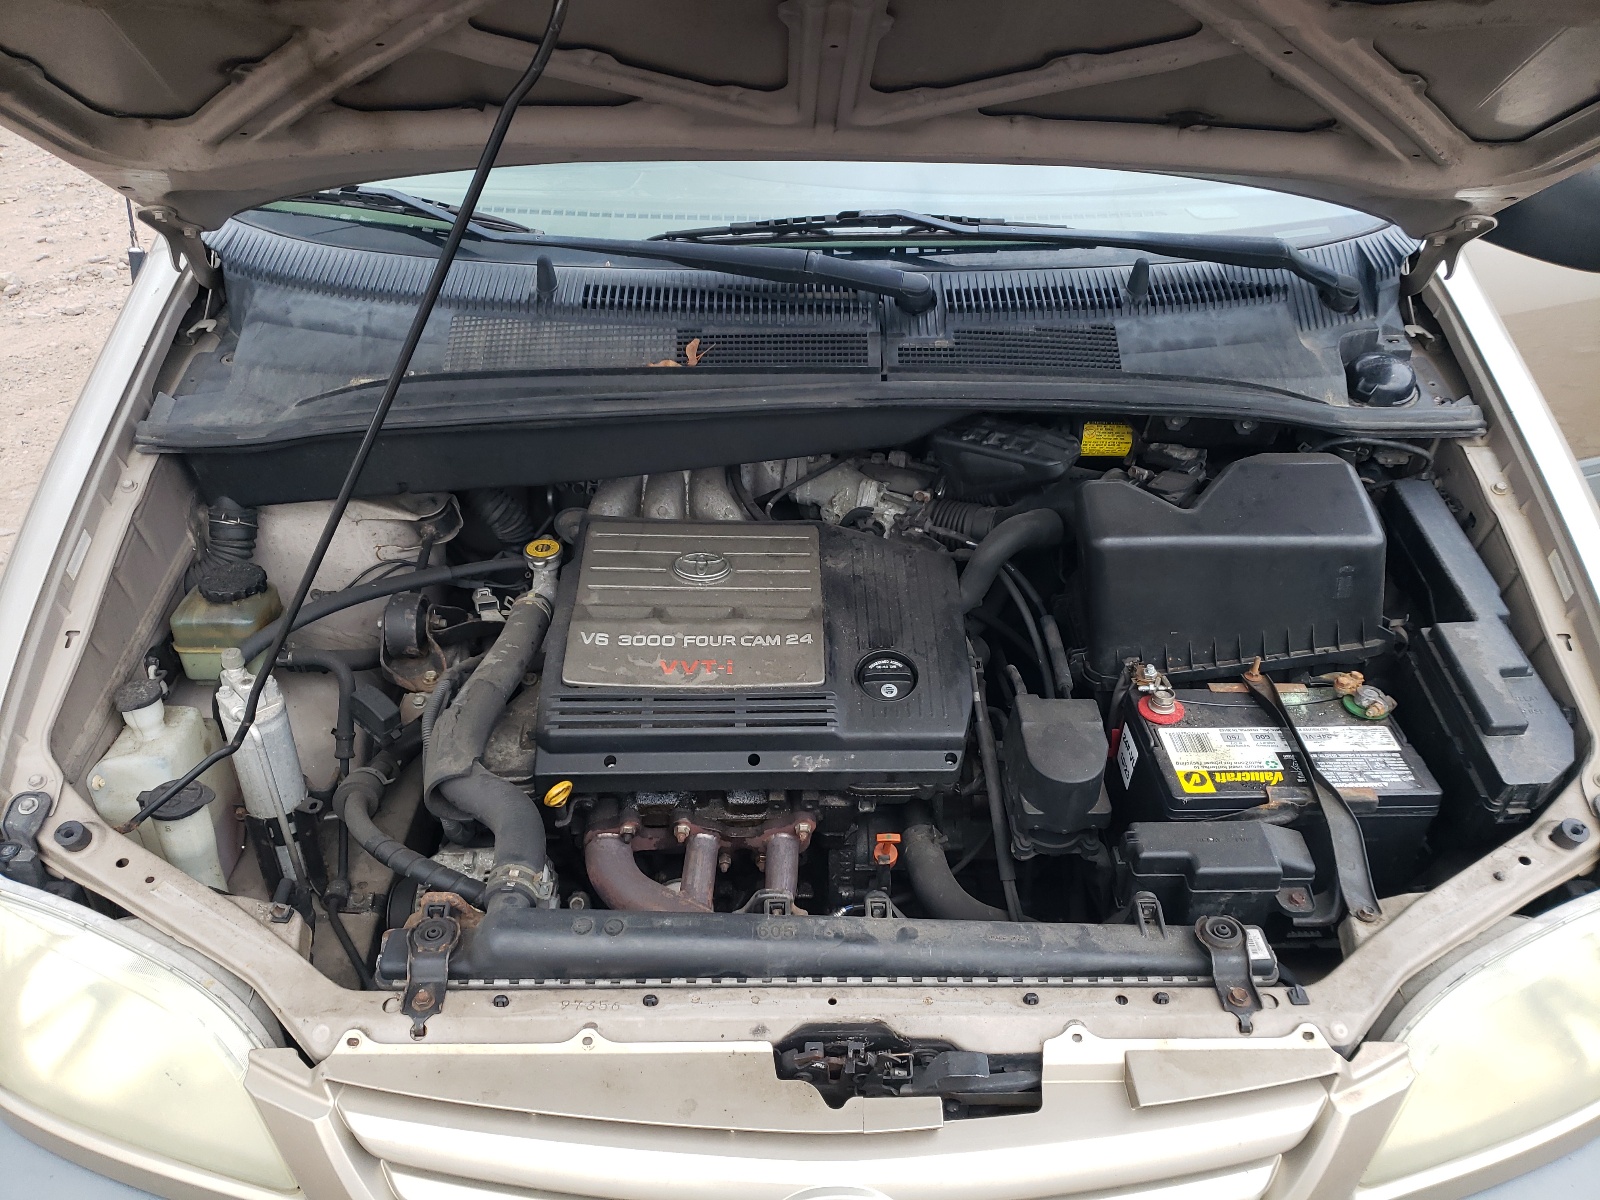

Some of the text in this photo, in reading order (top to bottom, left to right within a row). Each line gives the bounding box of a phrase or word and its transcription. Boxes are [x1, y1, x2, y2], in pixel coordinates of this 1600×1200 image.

[581, 632, 814, 647] V6 3000 FOUR CAM 24
[659, 659, 733, 675] VVT-i
[1214, 771, 1284, 786] Valucraft
